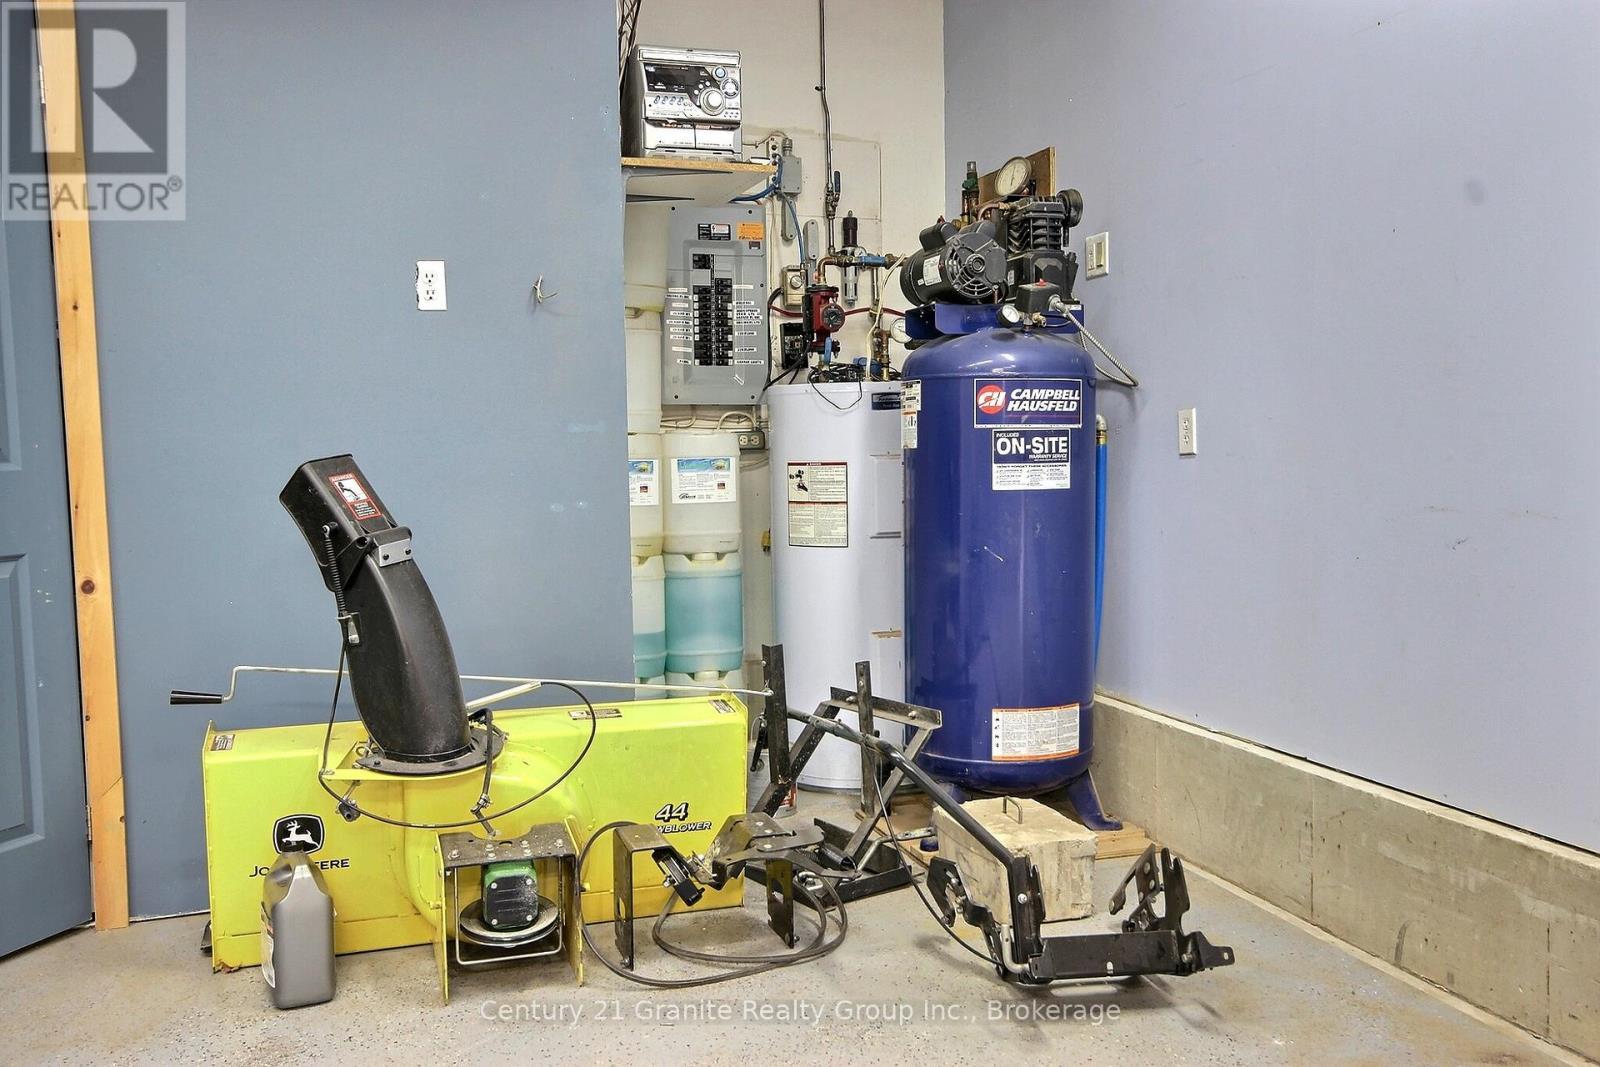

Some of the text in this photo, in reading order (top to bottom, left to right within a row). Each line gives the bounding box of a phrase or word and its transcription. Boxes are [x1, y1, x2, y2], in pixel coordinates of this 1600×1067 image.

[1010, 388, 1080, 400] CAMPBELL
[1006, 400, 1078, 412] HAUSFELD
[996, 436, 1068, 455] ON-SITE
[655, 802, 689, 823] 44
[657, 821, 712, 833] WBLOWER
[249, 865, 270, 878] JO
